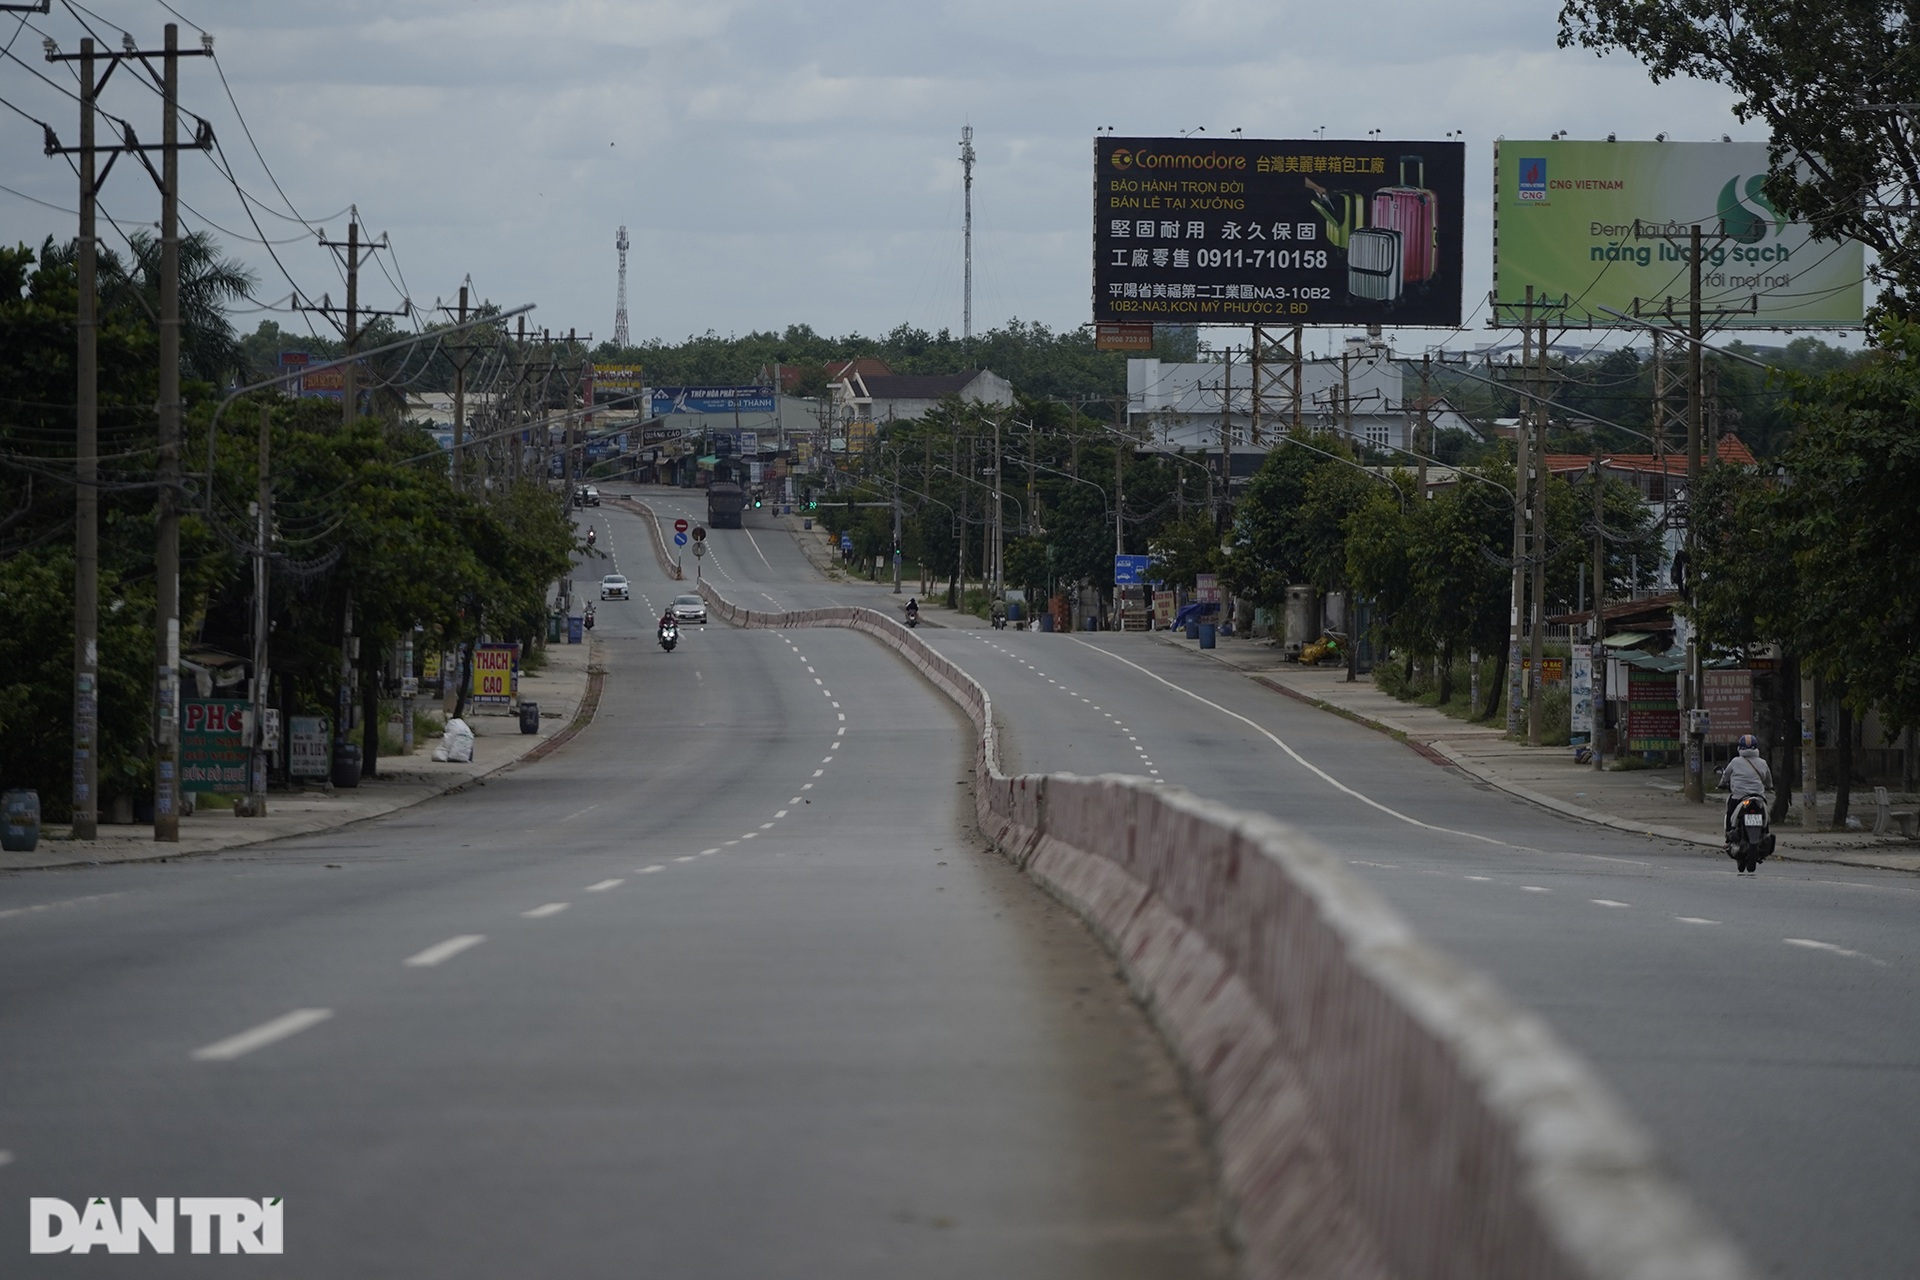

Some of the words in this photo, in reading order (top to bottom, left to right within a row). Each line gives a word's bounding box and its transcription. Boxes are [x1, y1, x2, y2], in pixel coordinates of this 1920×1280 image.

[1135, 149, 1247, 169] Commodore
[1256, 155, 1385, 173] 台灣美麗華箱包工廠
[1110, 178, 1138, 191] BẢO
[1141, 179, 1178, 192] HÀNH
[1180, 181, 1217, 194] TRỌN
[1219, 180, 1244, 193] ĐỜI
[1549, 180, 1572, 189] CNG
[1575, 180, 1623, 189] VIETNAM
[1110, 195, 1139, 208] BÁN
[1143, 196, 1160, 209] LẺ
[1164, 198, 1186, 211] TẠI
[1190, 197, 1245, 210] XƯỞNG
[1522, 191, 1543, 199] CNG
[1110, 219, 1205, 239] 堅固耐用
[1221, 221, 1317, 241] 永久保固
[1590, 222, 1629, 236] Đem
[1111, 248, 1190, 268] 工廠零售
[1196, 248, 1328, 269] 0911-710158
[1590, 242, 1651, 267] năng
[1732, 243, 1790, 267] sạch
[1730, 273, 1757, 290] mọi
[1764, 273, 1790, 287] nơi
[1201, 299, 1219, 312] MỸ
[1223, 301, 1273, 314] PHƯỚC
[1289, 303, 1308, 314] BD
[476, 652, 509, 673] THẠCH
[483, 675, 502, 693] CAO
[182, 763, 206, 781] BÚN
[223, 762, 247, 782] HUẾ
